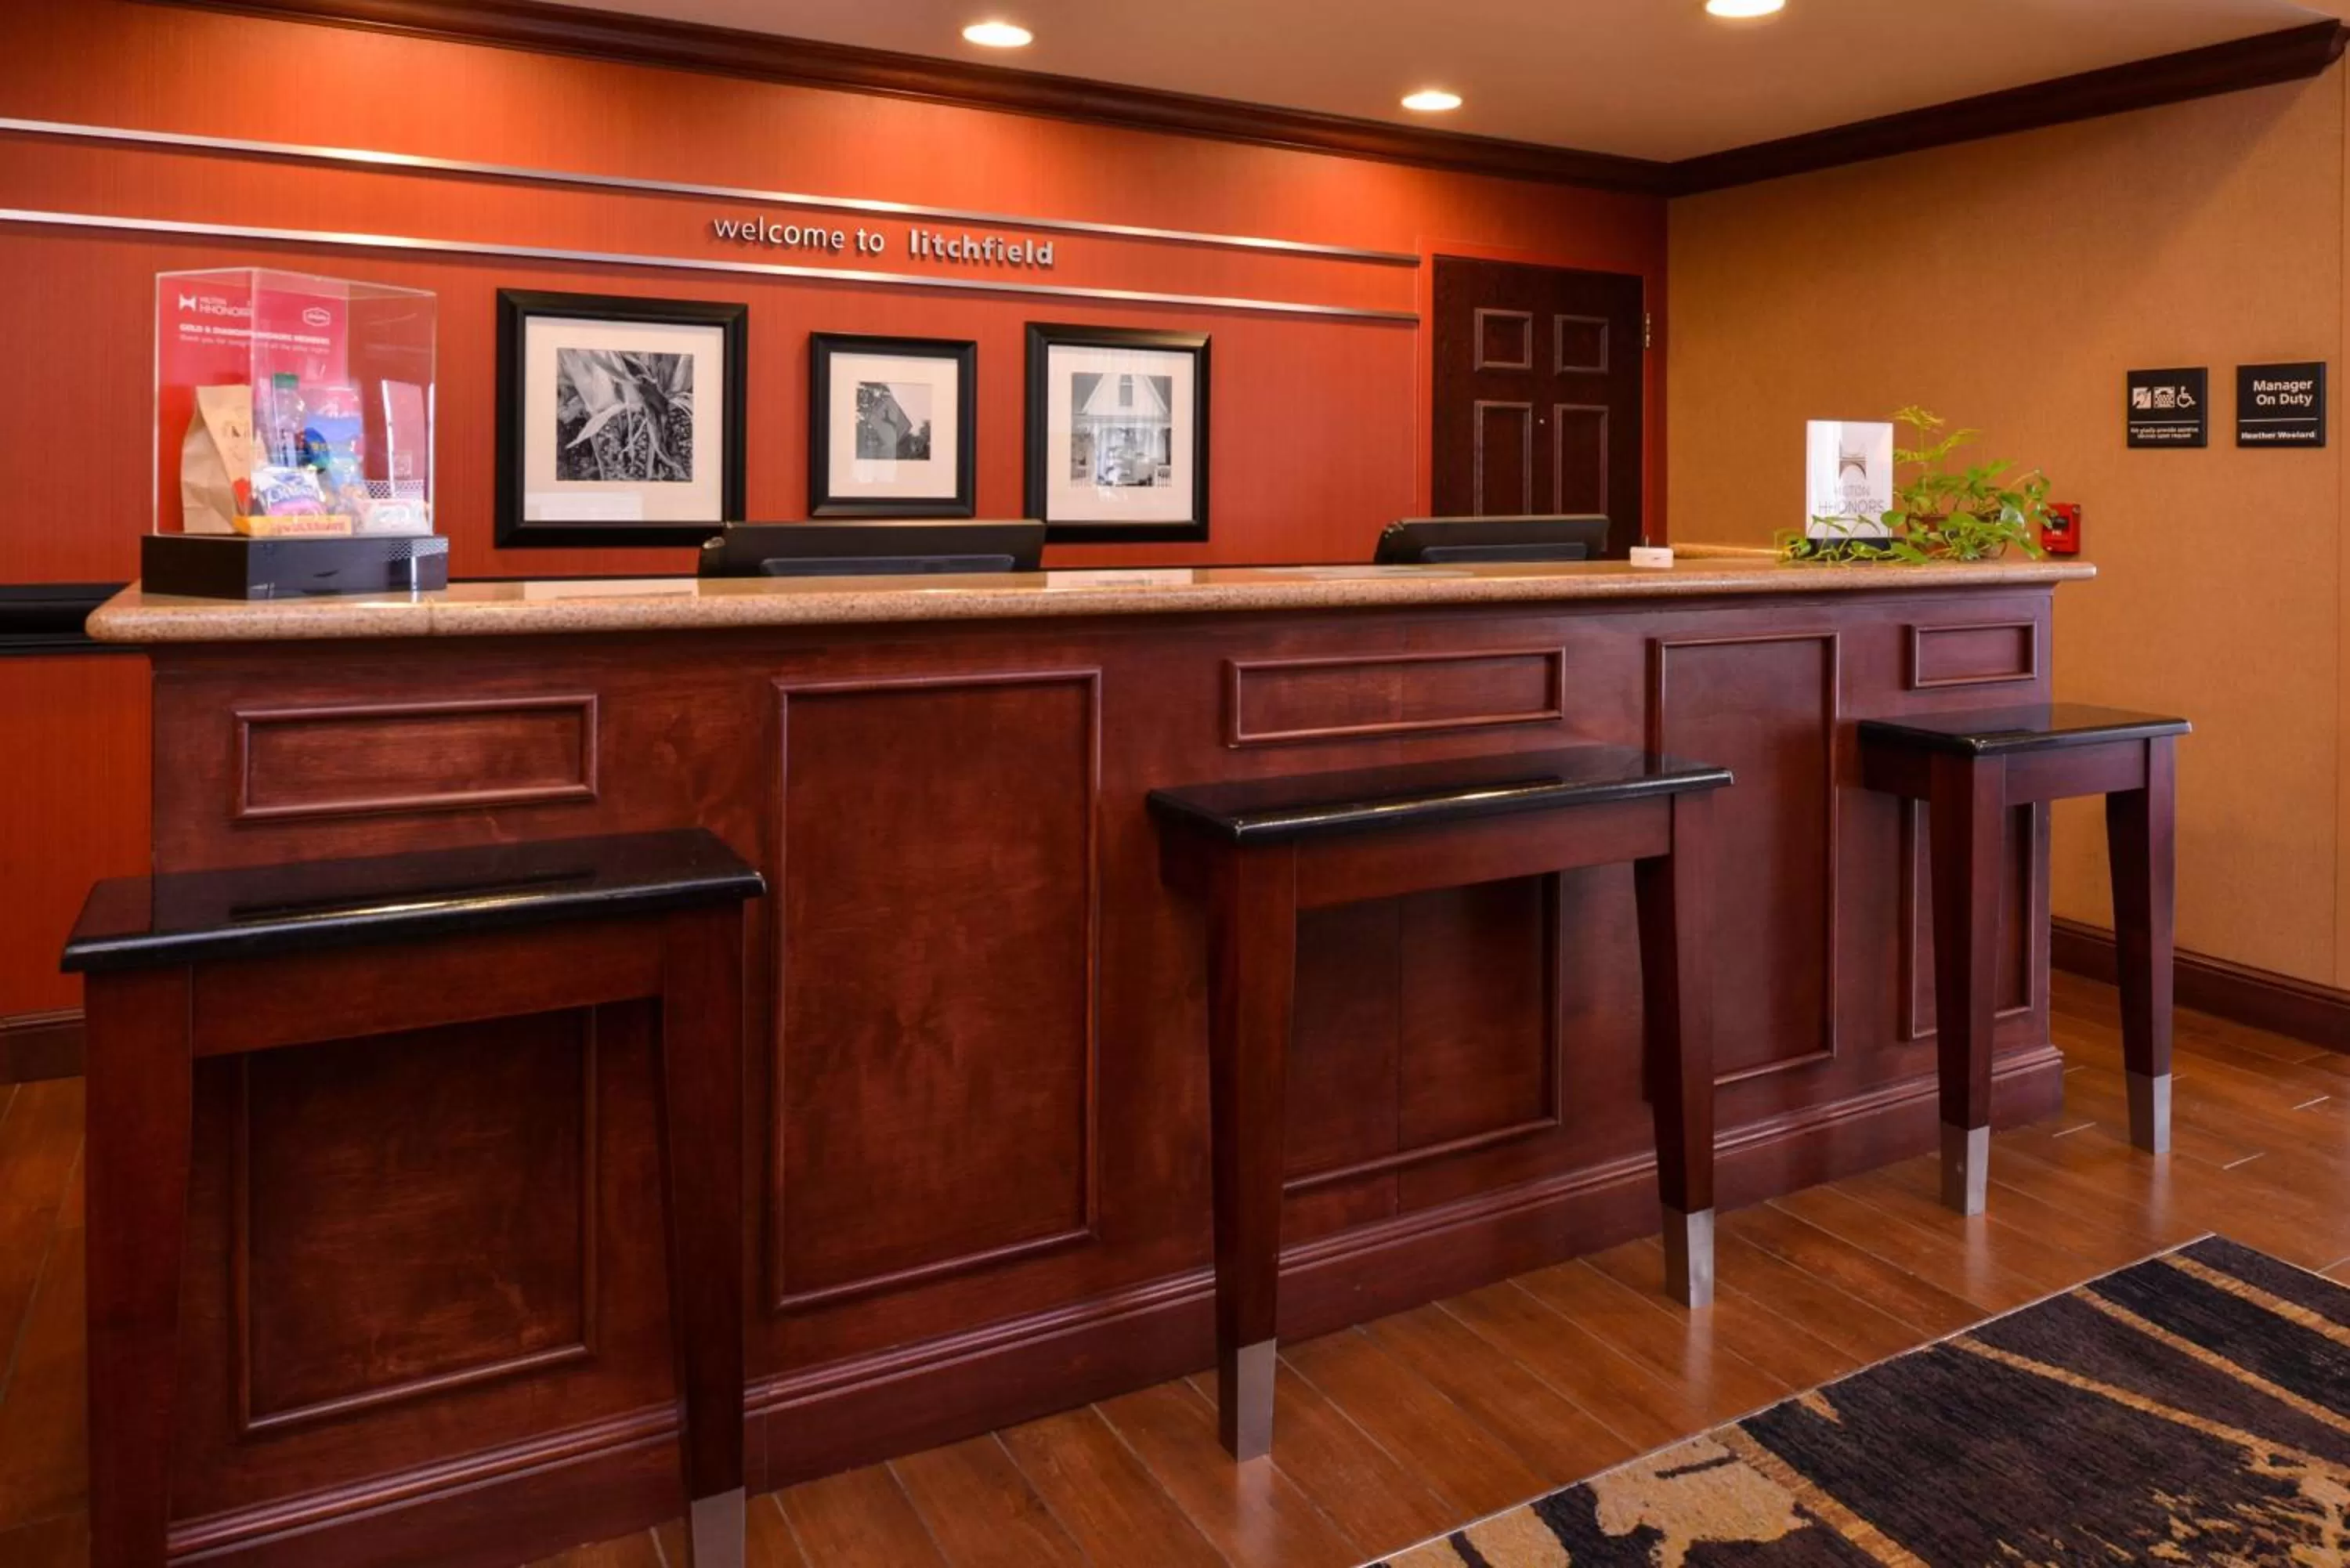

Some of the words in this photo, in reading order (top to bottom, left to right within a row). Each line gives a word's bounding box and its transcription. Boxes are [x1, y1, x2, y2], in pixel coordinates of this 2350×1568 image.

[714, 216, 845, 250] welcome
[857, 228, 885, 252] to
[909, 229, 1054, 266] litchfield
[2253, 380, 2313, 393] Manager
[2256, 395, 2276, 406] On
[2280, 393, 2313, 407] Duty
